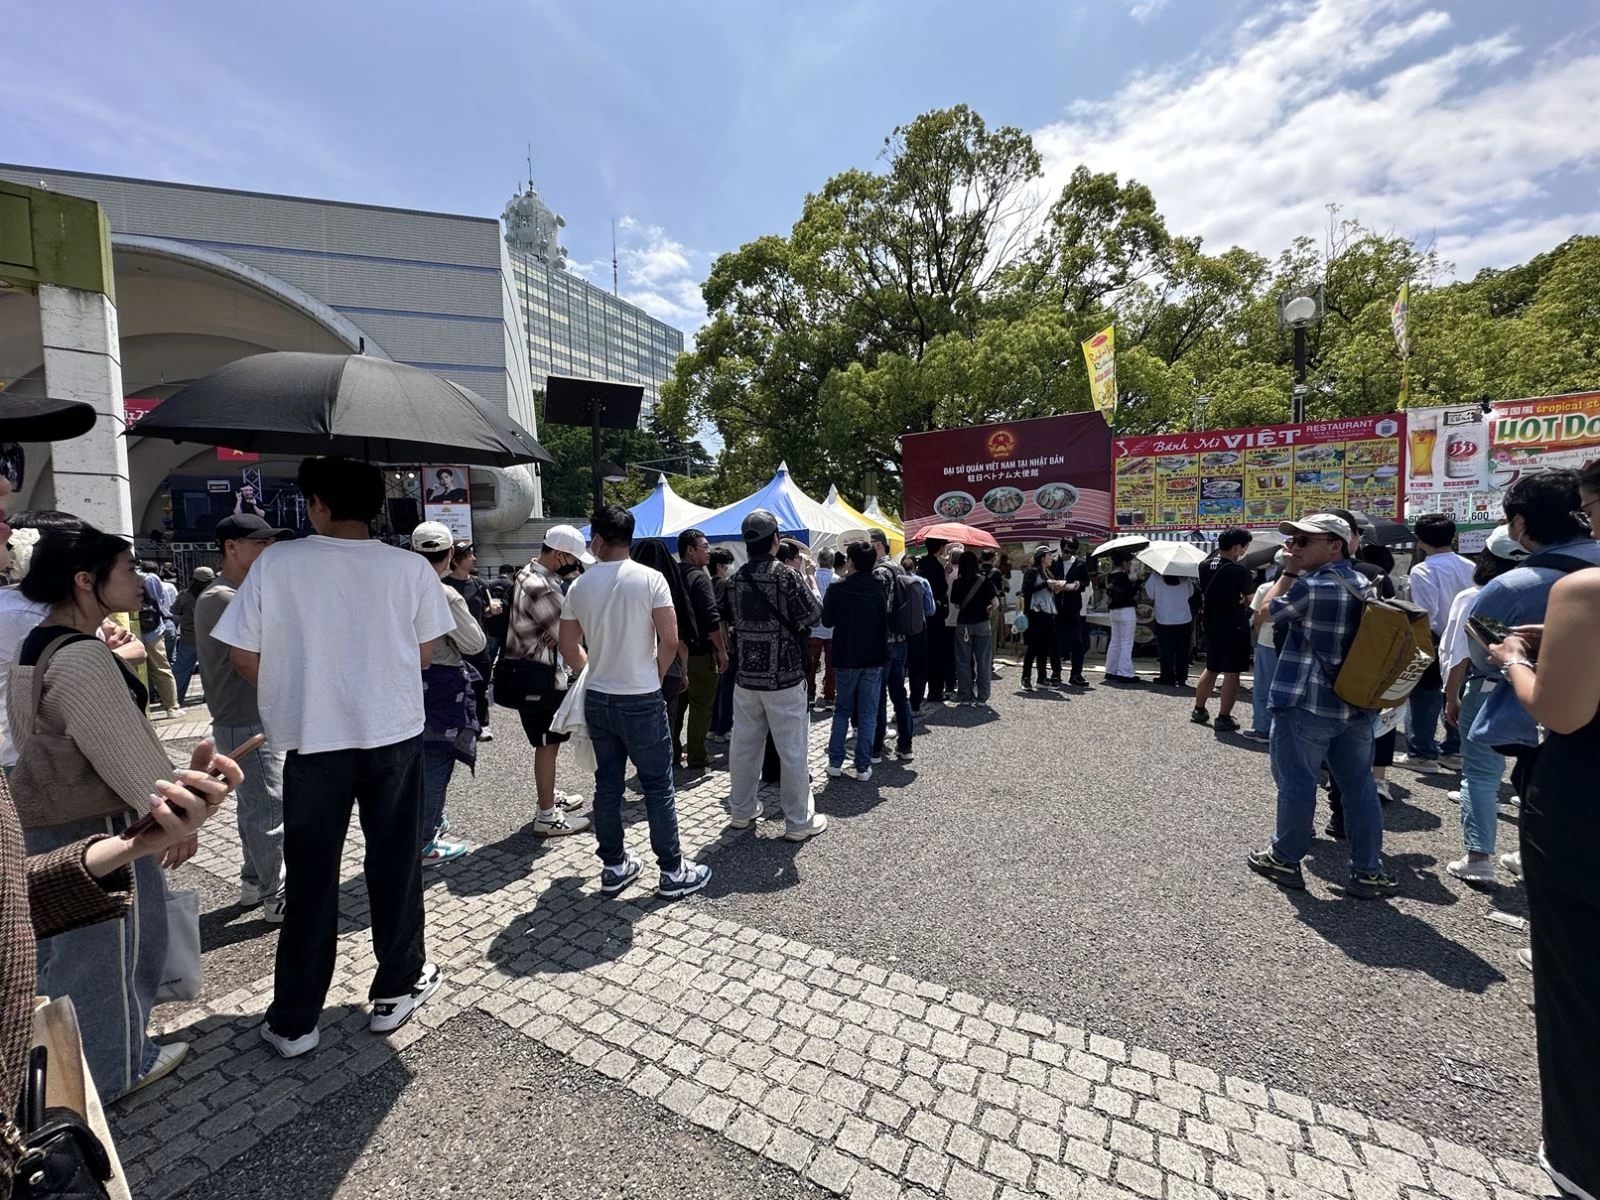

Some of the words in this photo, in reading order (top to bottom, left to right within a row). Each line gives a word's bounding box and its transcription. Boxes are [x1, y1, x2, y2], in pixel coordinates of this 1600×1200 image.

[1536, 401, 1583, 415] tropical
[1306, 420, 1374, 433] RESTAURANT
[1494, 414, 1562, 445] HOT
[1449, 440, 1474, 456] 333
[965, 461, 984, 474] QUÁN
[985, 460, 999, 471] VIỆT
[1000, 460, 1016, 470] NAM
[1029, 455, 1048, 468] NHẬT
[1471, 511, 1489, 521] 600
